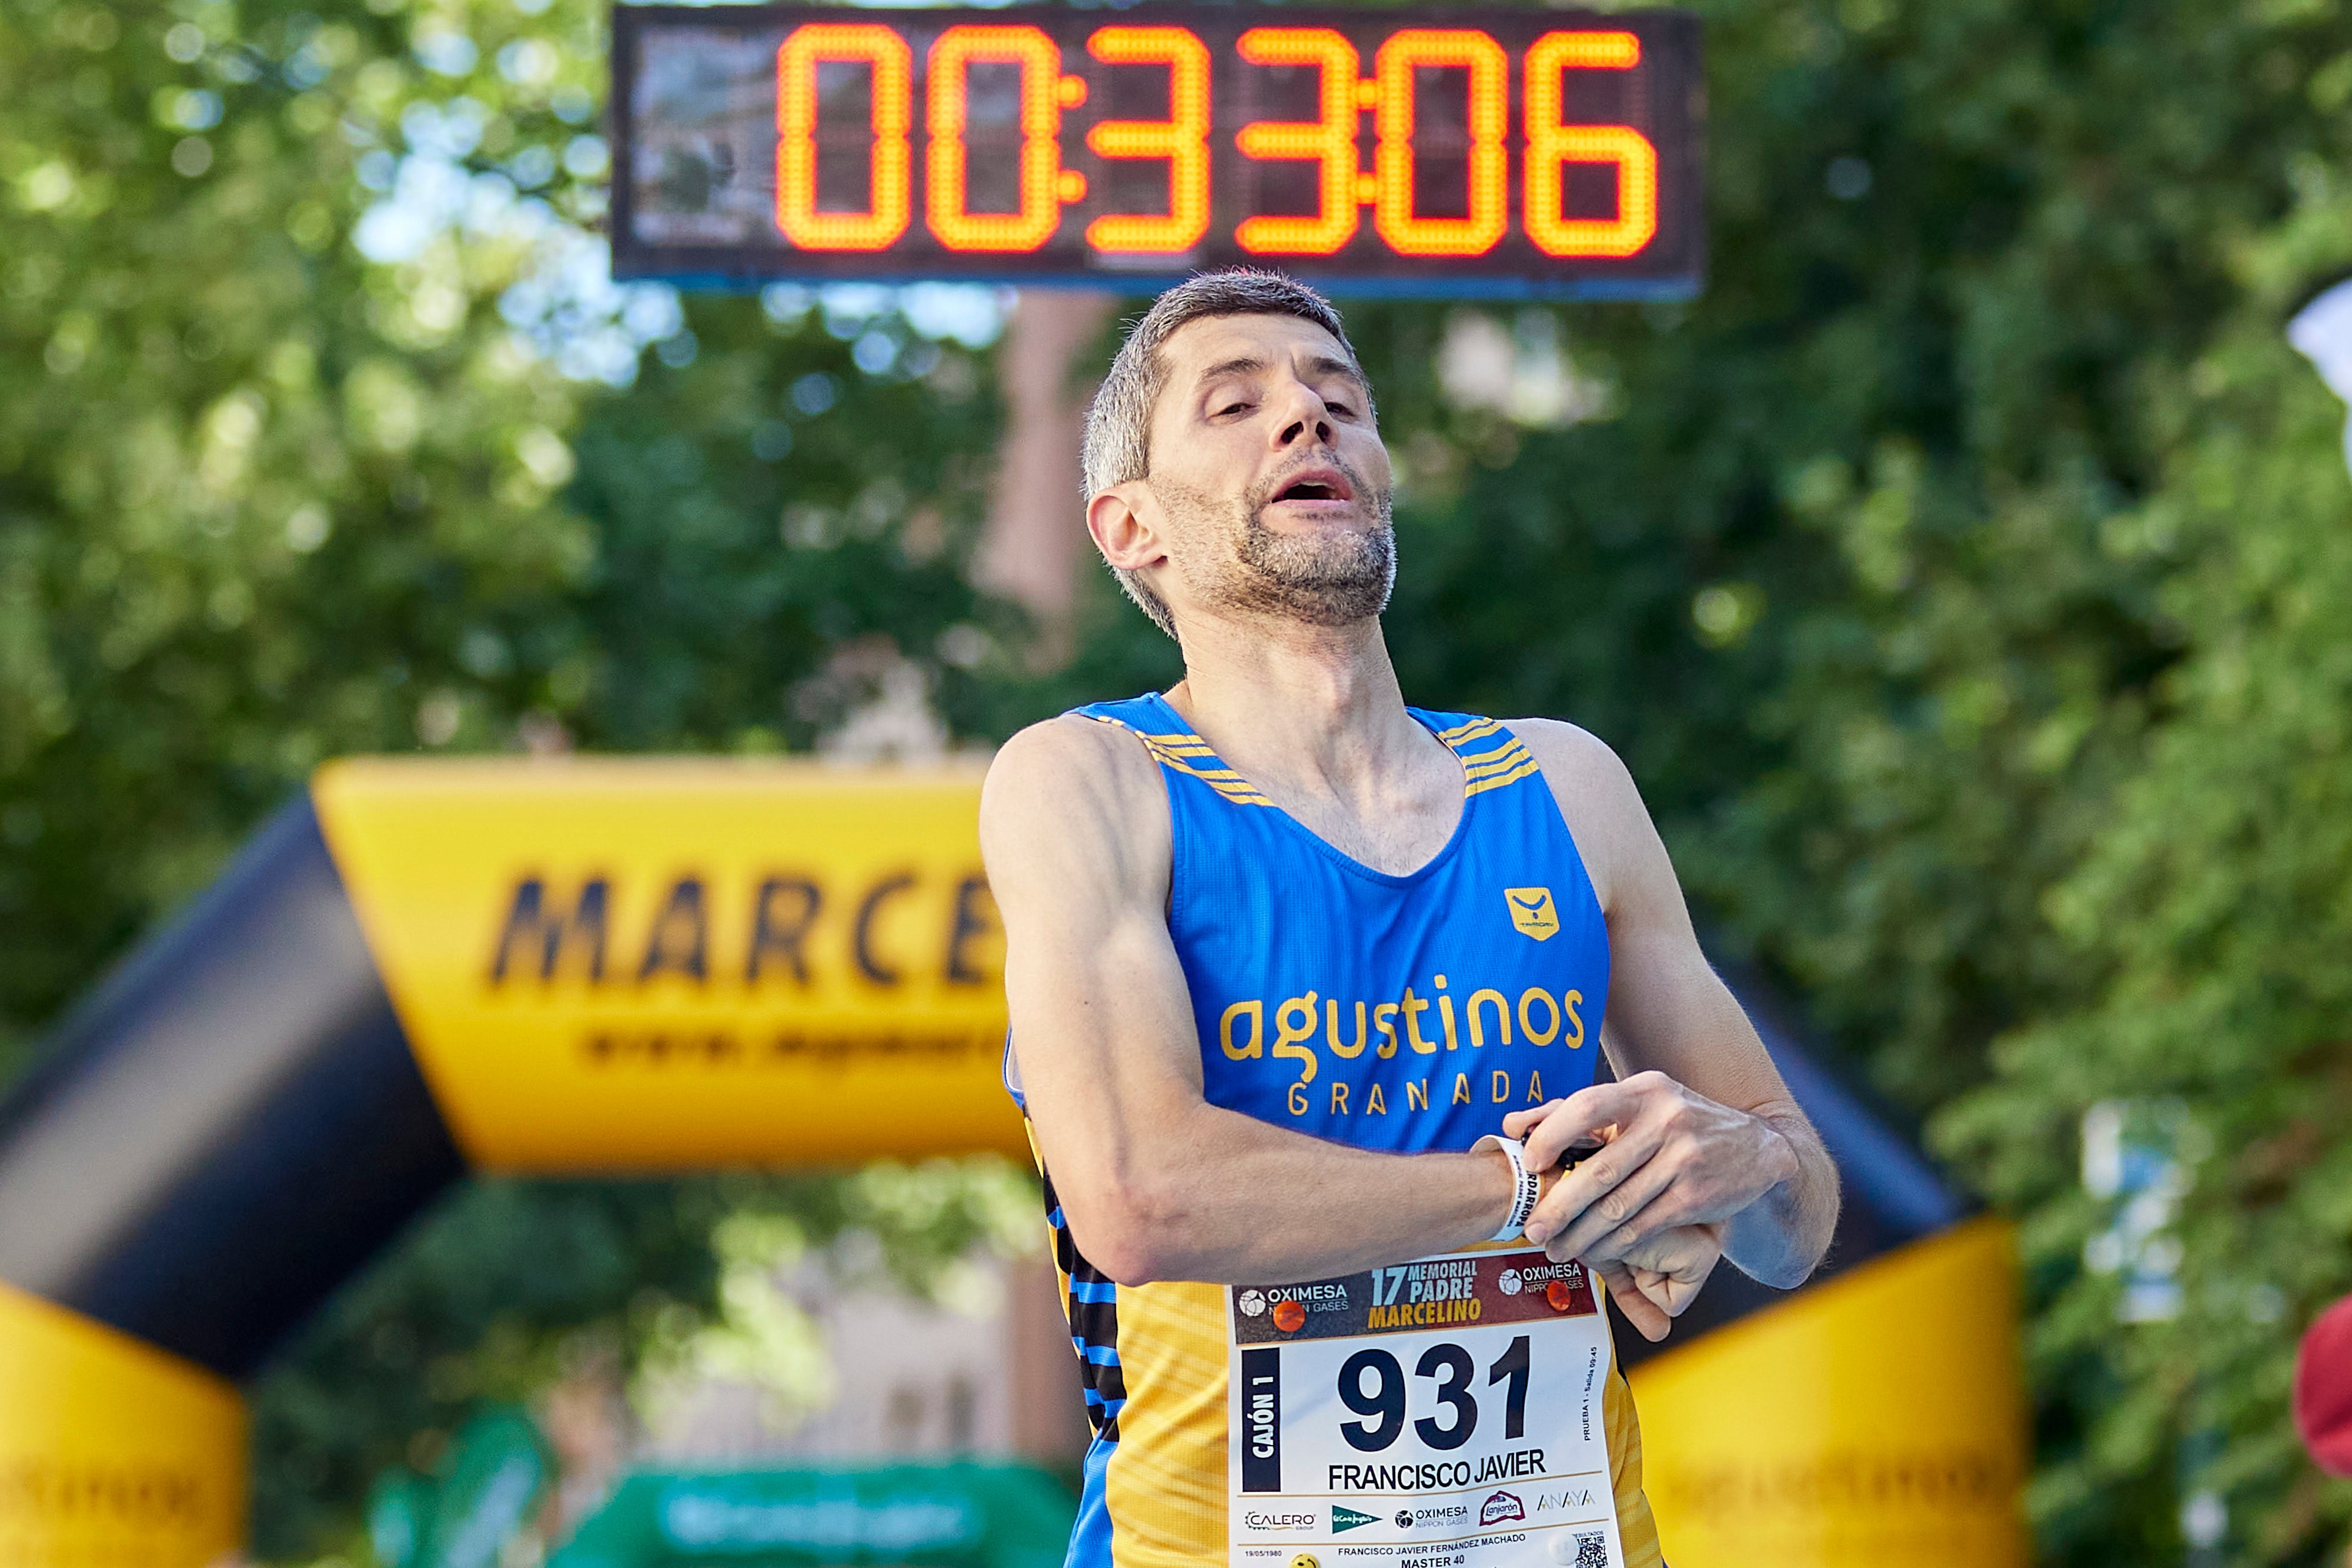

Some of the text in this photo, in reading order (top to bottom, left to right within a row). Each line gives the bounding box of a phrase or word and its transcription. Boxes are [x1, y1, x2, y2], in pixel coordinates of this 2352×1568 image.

[1220, 974, 1585, 1083] agustinos
[1288, 1069, 1543, 1116] GRANADA
[1515, 1170, 1537, 1228] RDARROPA
[1371, 1261, 1478, 1307] 17 MEMORIAL
[1523, 1263, 1582, 1281] OXIMESA
[1268, 1284, 1348, 1303] OXIMESA
[1410, 1278, 1474, 1303] PADRE
[1313, 1300, 1349, 1312] GASES
[1368, 1298, 1481, 1329] MARCELINO
[1338, 1335, 1530, 1452] 931
[1247, 1375, 1275, 1459] CAJÓN 1
[1582, 1405, 1591, 1441] PRUEBA
[1329, 1448, 1547, 1490] FRANCISCO JAVIER
[1416, 1506, 1468, 1519] OXIMESA
[1537, 1489, 1595, 1512] ANAYA
[1251, 1514, 1315, 1526] CALERO
[1416, 1516, 1468, 1529] NIPPON GASES
[1338, 1534, 1526, 1556] FRANCISCO JAVIER FERNÁNDEZ MACHADO
[1401, 1554, 1465, 1568] MASTER 40
